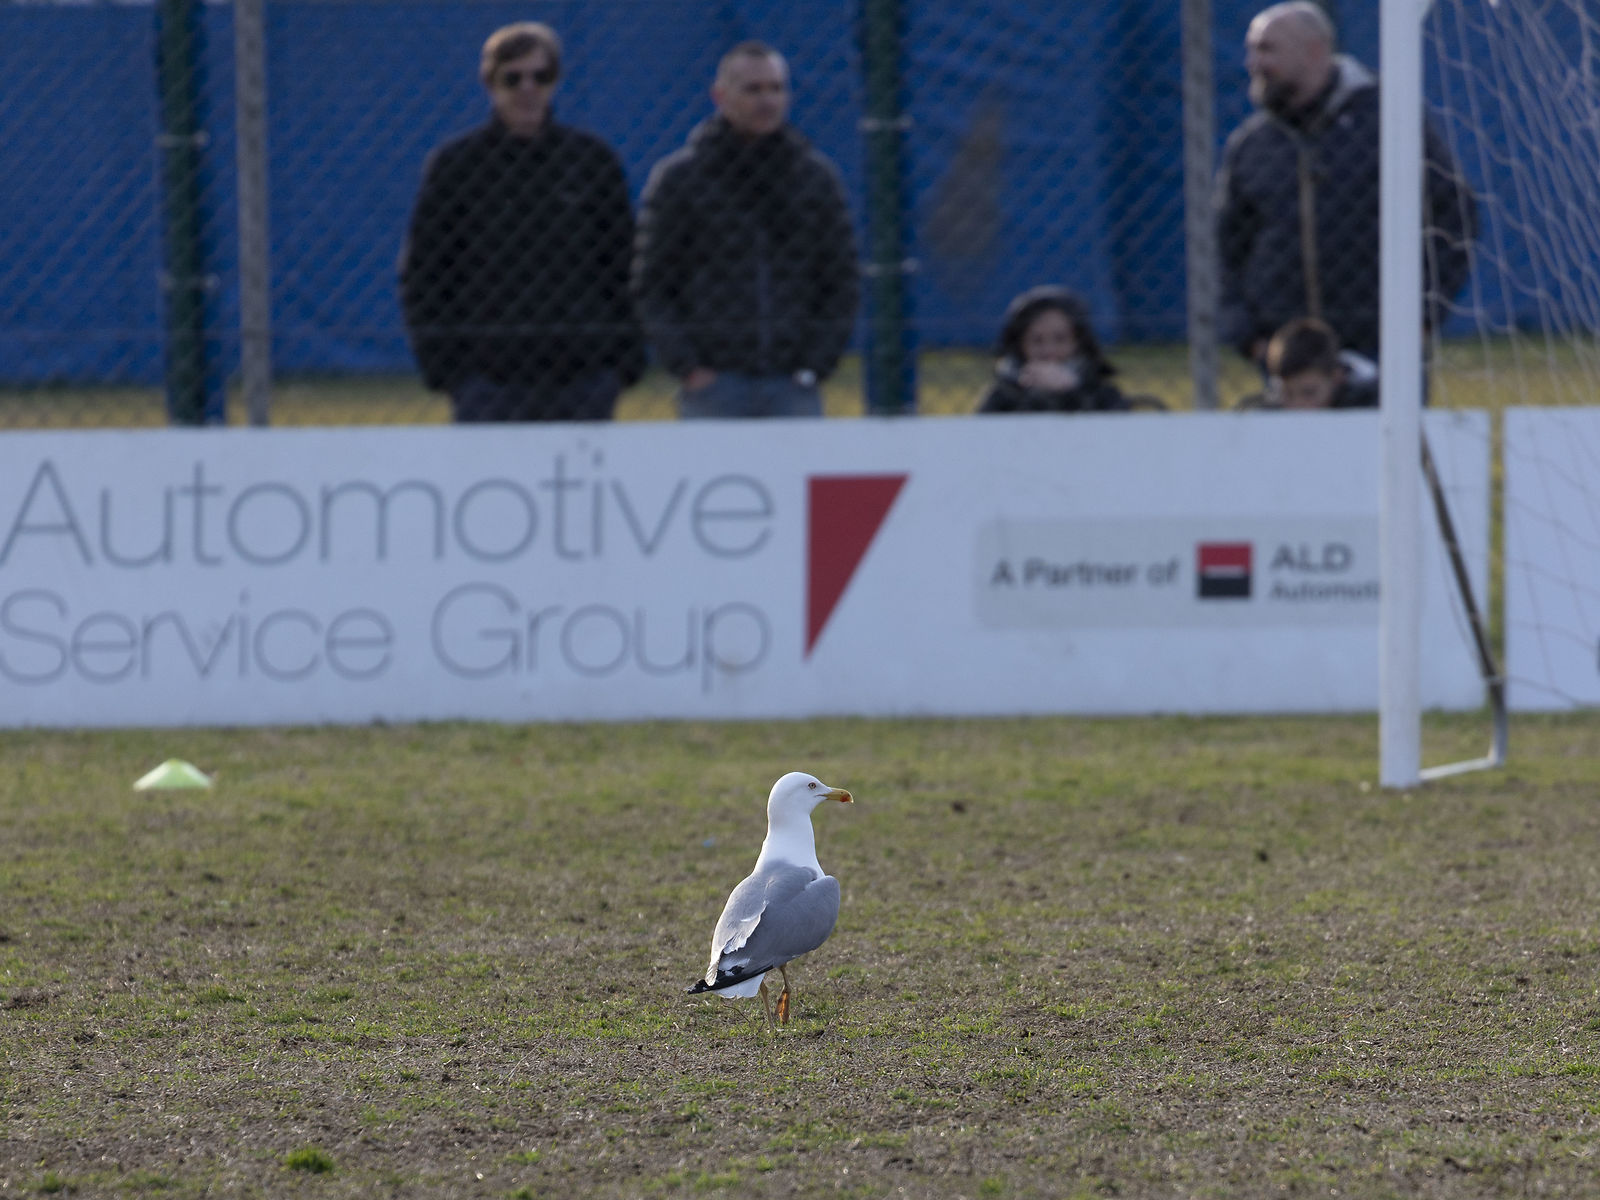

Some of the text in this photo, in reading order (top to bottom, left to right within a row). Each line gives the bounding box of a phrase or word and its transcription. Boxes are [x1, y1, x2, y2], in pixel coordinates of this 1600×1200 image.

[0, 450, 775, 568] Automotive
[991, 557, 1180, 587] A Partner of
[1270, 542, 1353, 573] ALD
[1271, 580, 1380, 601] Automoti
[0, 581, 772, 694] Service Group
